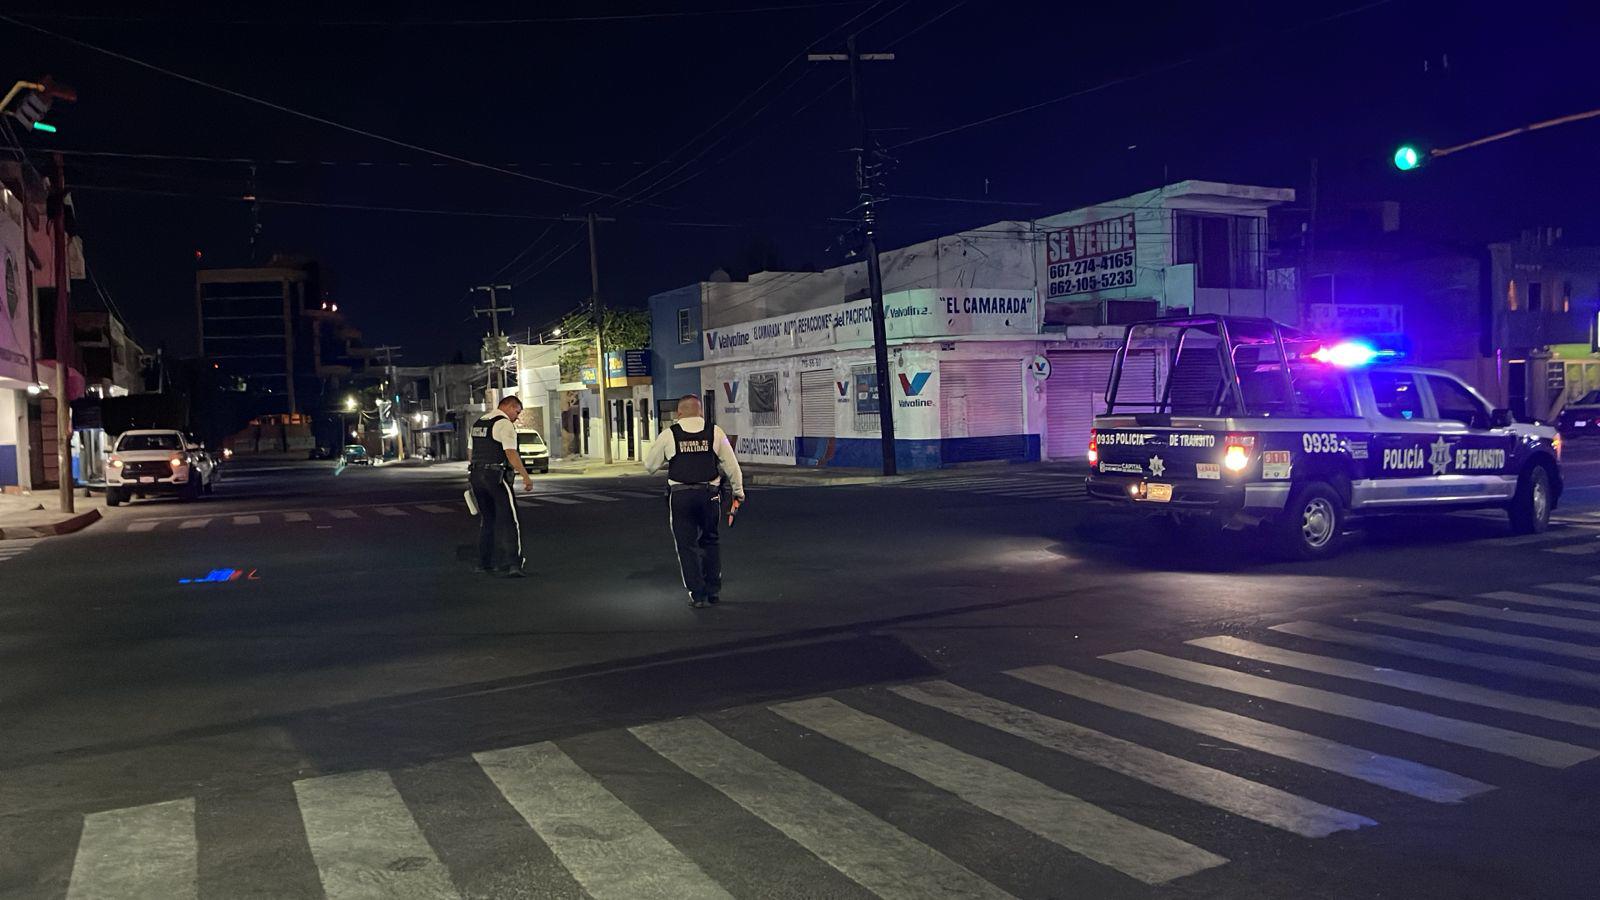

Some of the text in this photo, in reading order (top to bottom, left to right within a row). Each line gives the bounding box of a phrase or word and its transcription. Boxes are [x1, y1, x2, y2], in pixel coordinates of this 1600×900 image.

[1049, 215, 1134, 262] SE VENDE
[1050, 252, 1133, 279] 667-274-4165
[1050, 270, 1133, 295] 662-105-5233
[718, 332, 750, 349] Valvoline
[679, 445, 709, 453] VIALIDAD
[1096, 434, 1115, 445] 0935
[1169, 434, 1179, 446] DE
[1180, 434, 1215, 447] TRANSITO
[1302, 433, 1338, 453] 0935
[1383, 444, 1424, 469] POLICÍA
[1455, 449, 1466, 469] DE
[1467, 449, 1505, 469] TRANSITO
